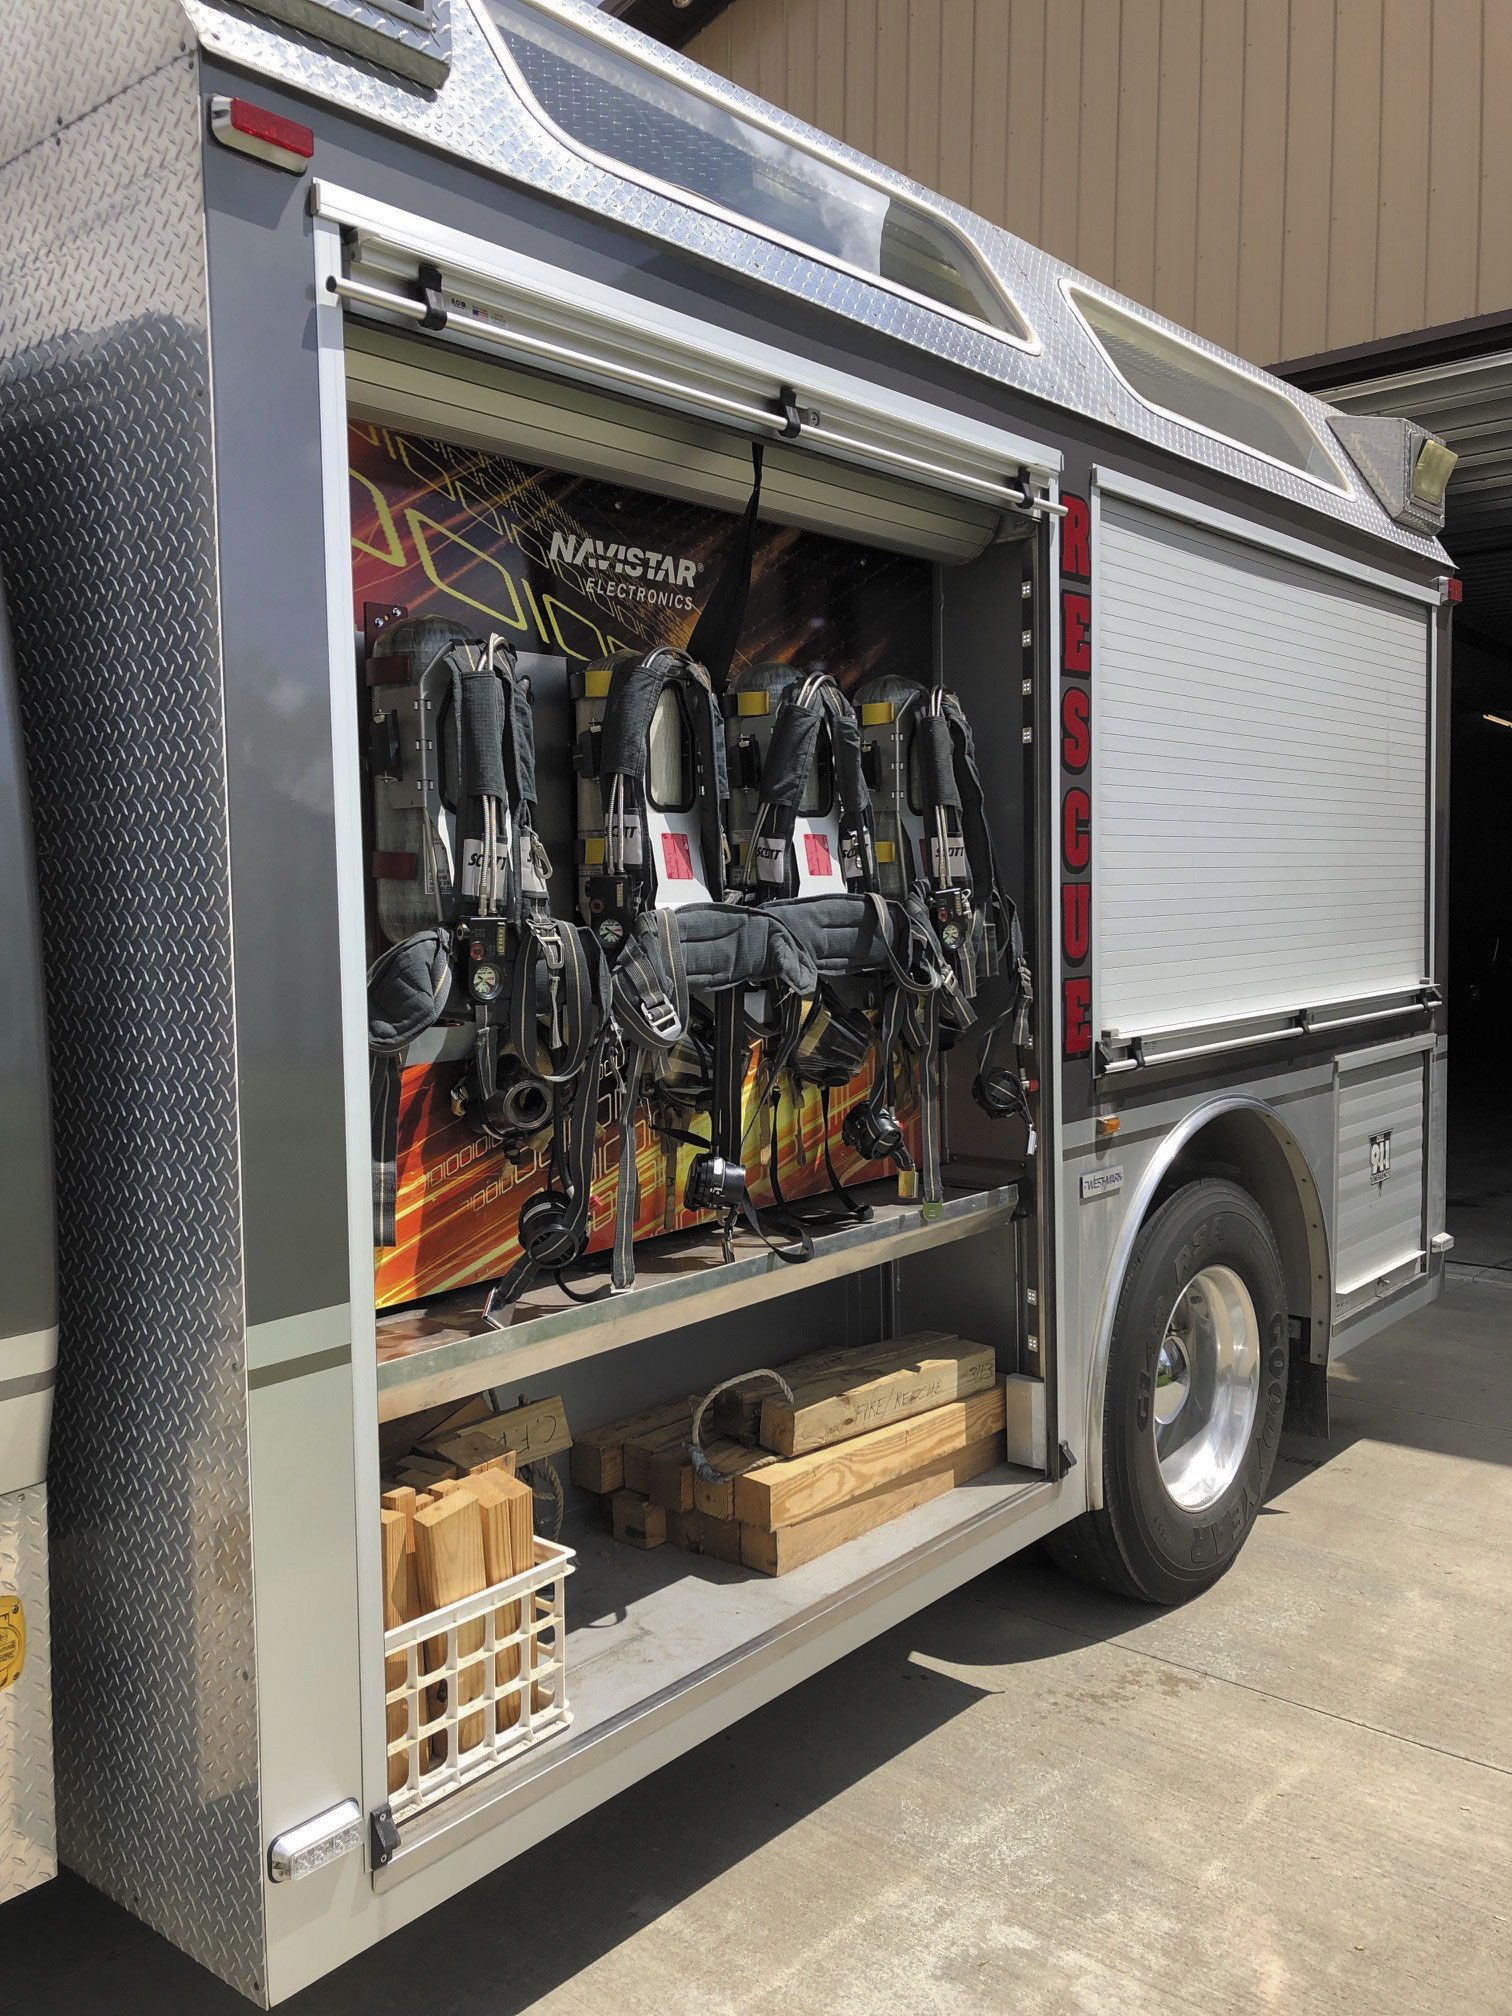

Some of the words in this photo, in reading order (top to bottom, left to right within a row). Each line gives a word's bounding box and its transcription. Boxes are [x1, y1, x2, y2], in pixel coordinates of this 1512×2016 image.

[585, 577, 693, 611] ELECTRONICS
[1061, 494, 1091, 1057] RESCUE
[1371, 1140, 1390, 1175] 911
